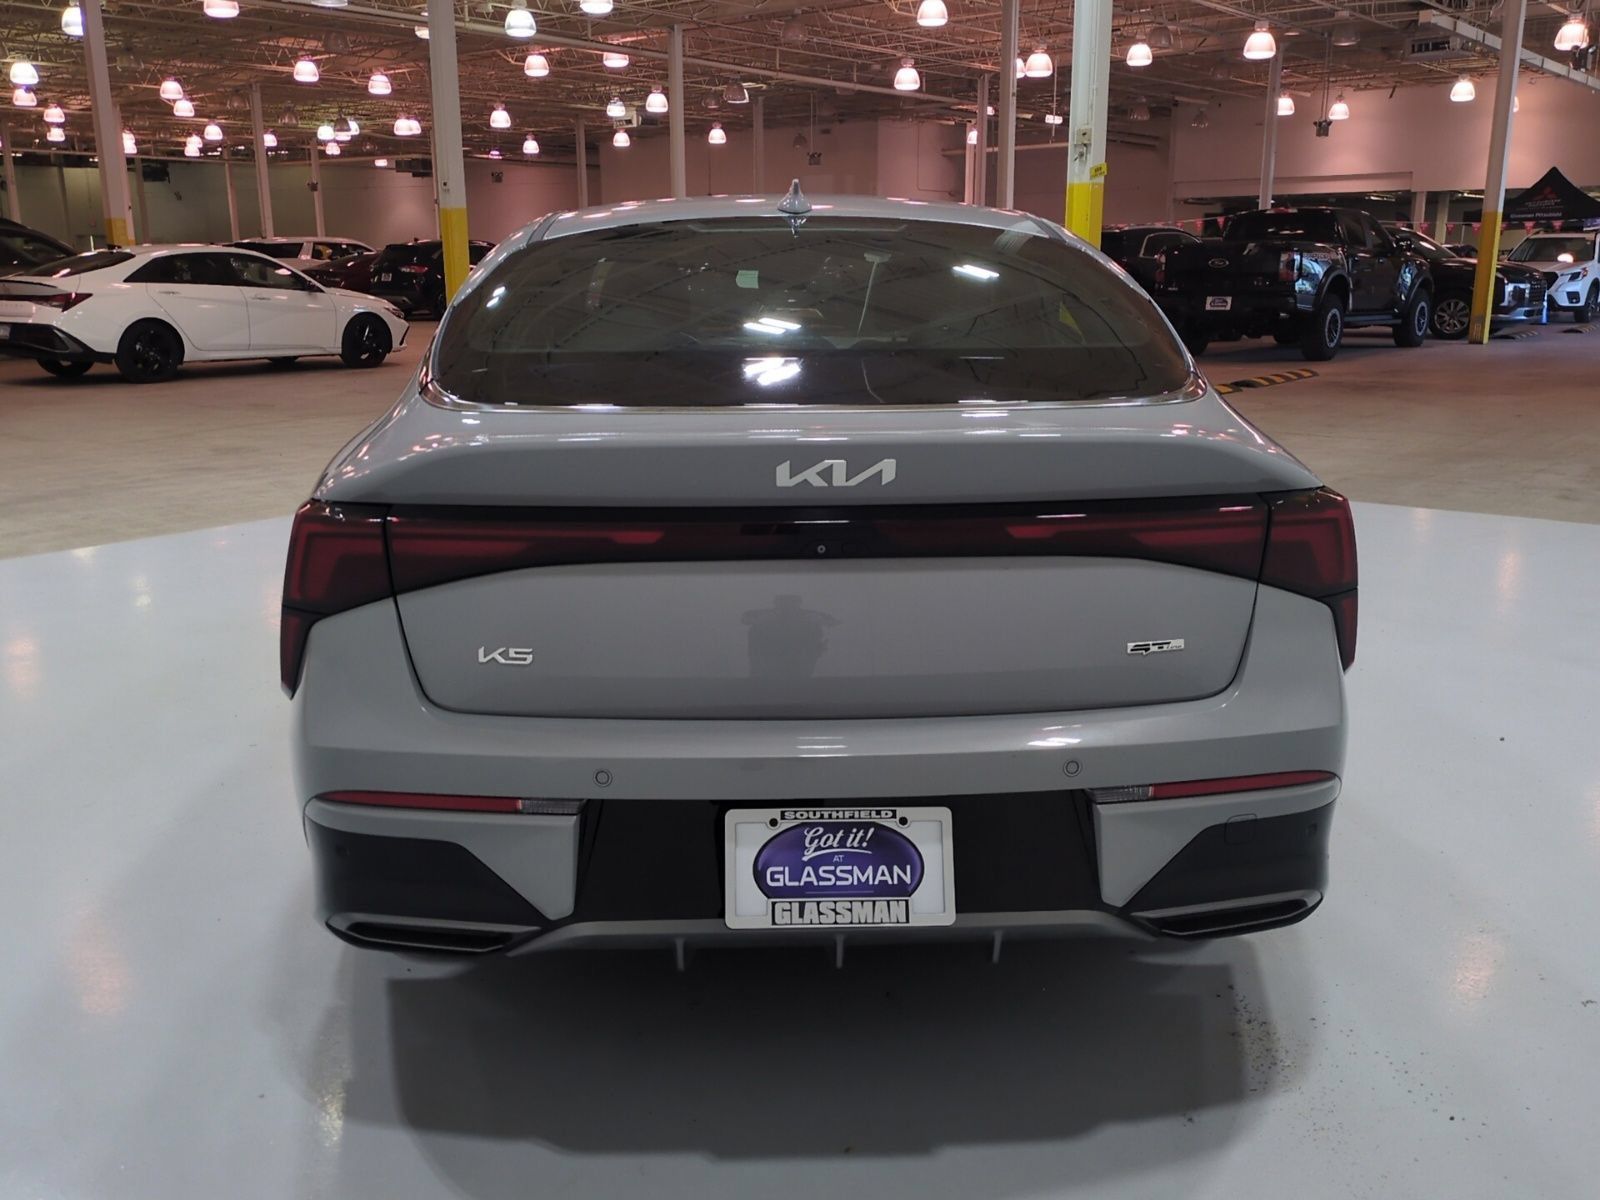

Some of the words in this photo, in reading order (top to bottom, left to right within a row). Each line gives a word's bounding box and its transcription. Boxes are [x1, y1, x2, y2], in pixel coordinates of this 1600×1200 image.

[776, 459, 897, 487] KIA
[478, 645, 533, 665] K5
[783, 810, 893, 820] SOUTHFIELD
[803, 826, 844, 854] Got
[846, 826, 875, 848] it!
[832, 854, 844, 863] AT
[766, 865, 912, 886] GLASSMAN
[774, 901, 907, 924] GLASSMAN
